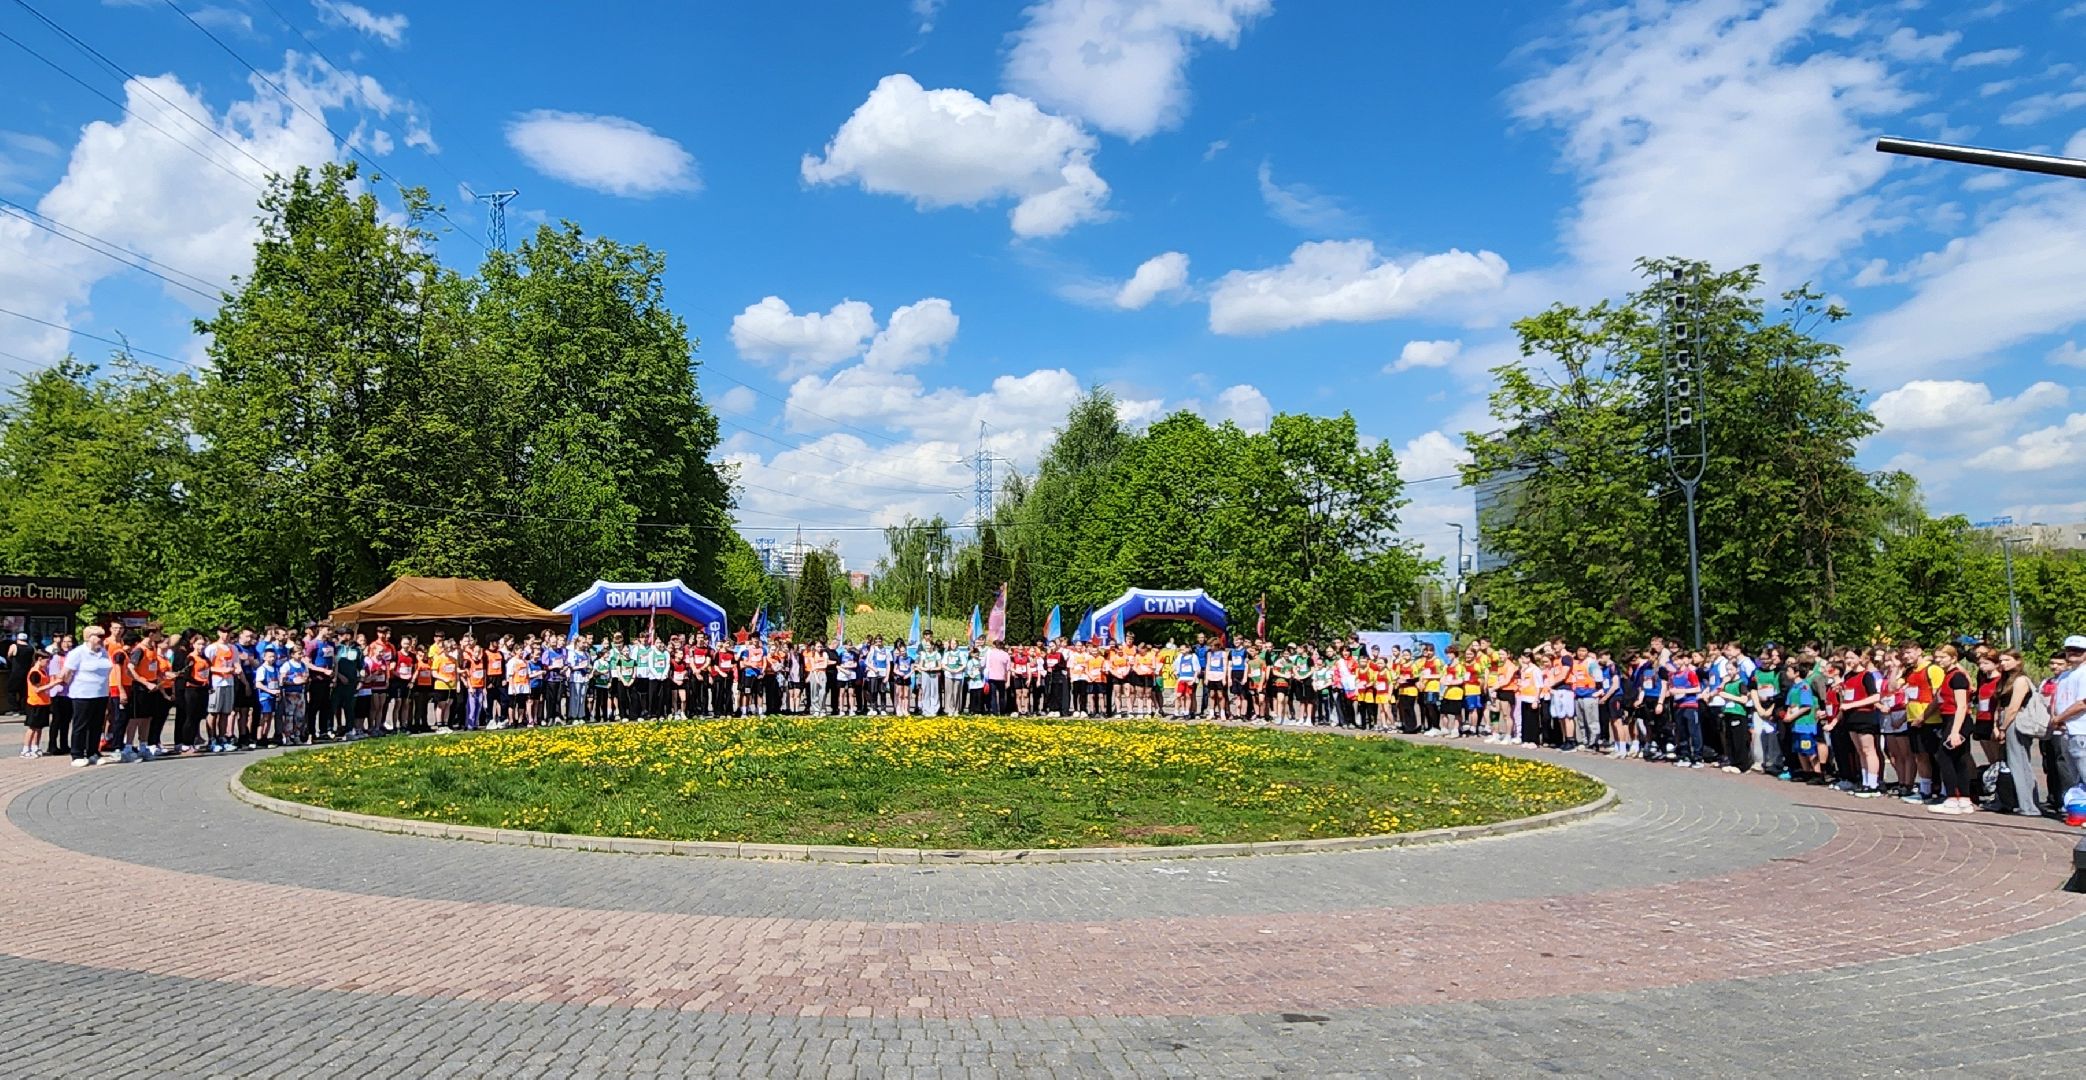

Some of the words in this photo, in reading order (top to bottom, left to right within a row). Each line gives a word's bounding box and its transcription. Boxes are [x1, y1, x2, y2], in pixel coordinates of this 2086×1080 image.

[27, 582, 88, 602] Станция
[606, 591, 672, 608] ФИНИШ
[1144, 597, 1197, 614] СТАРТ
